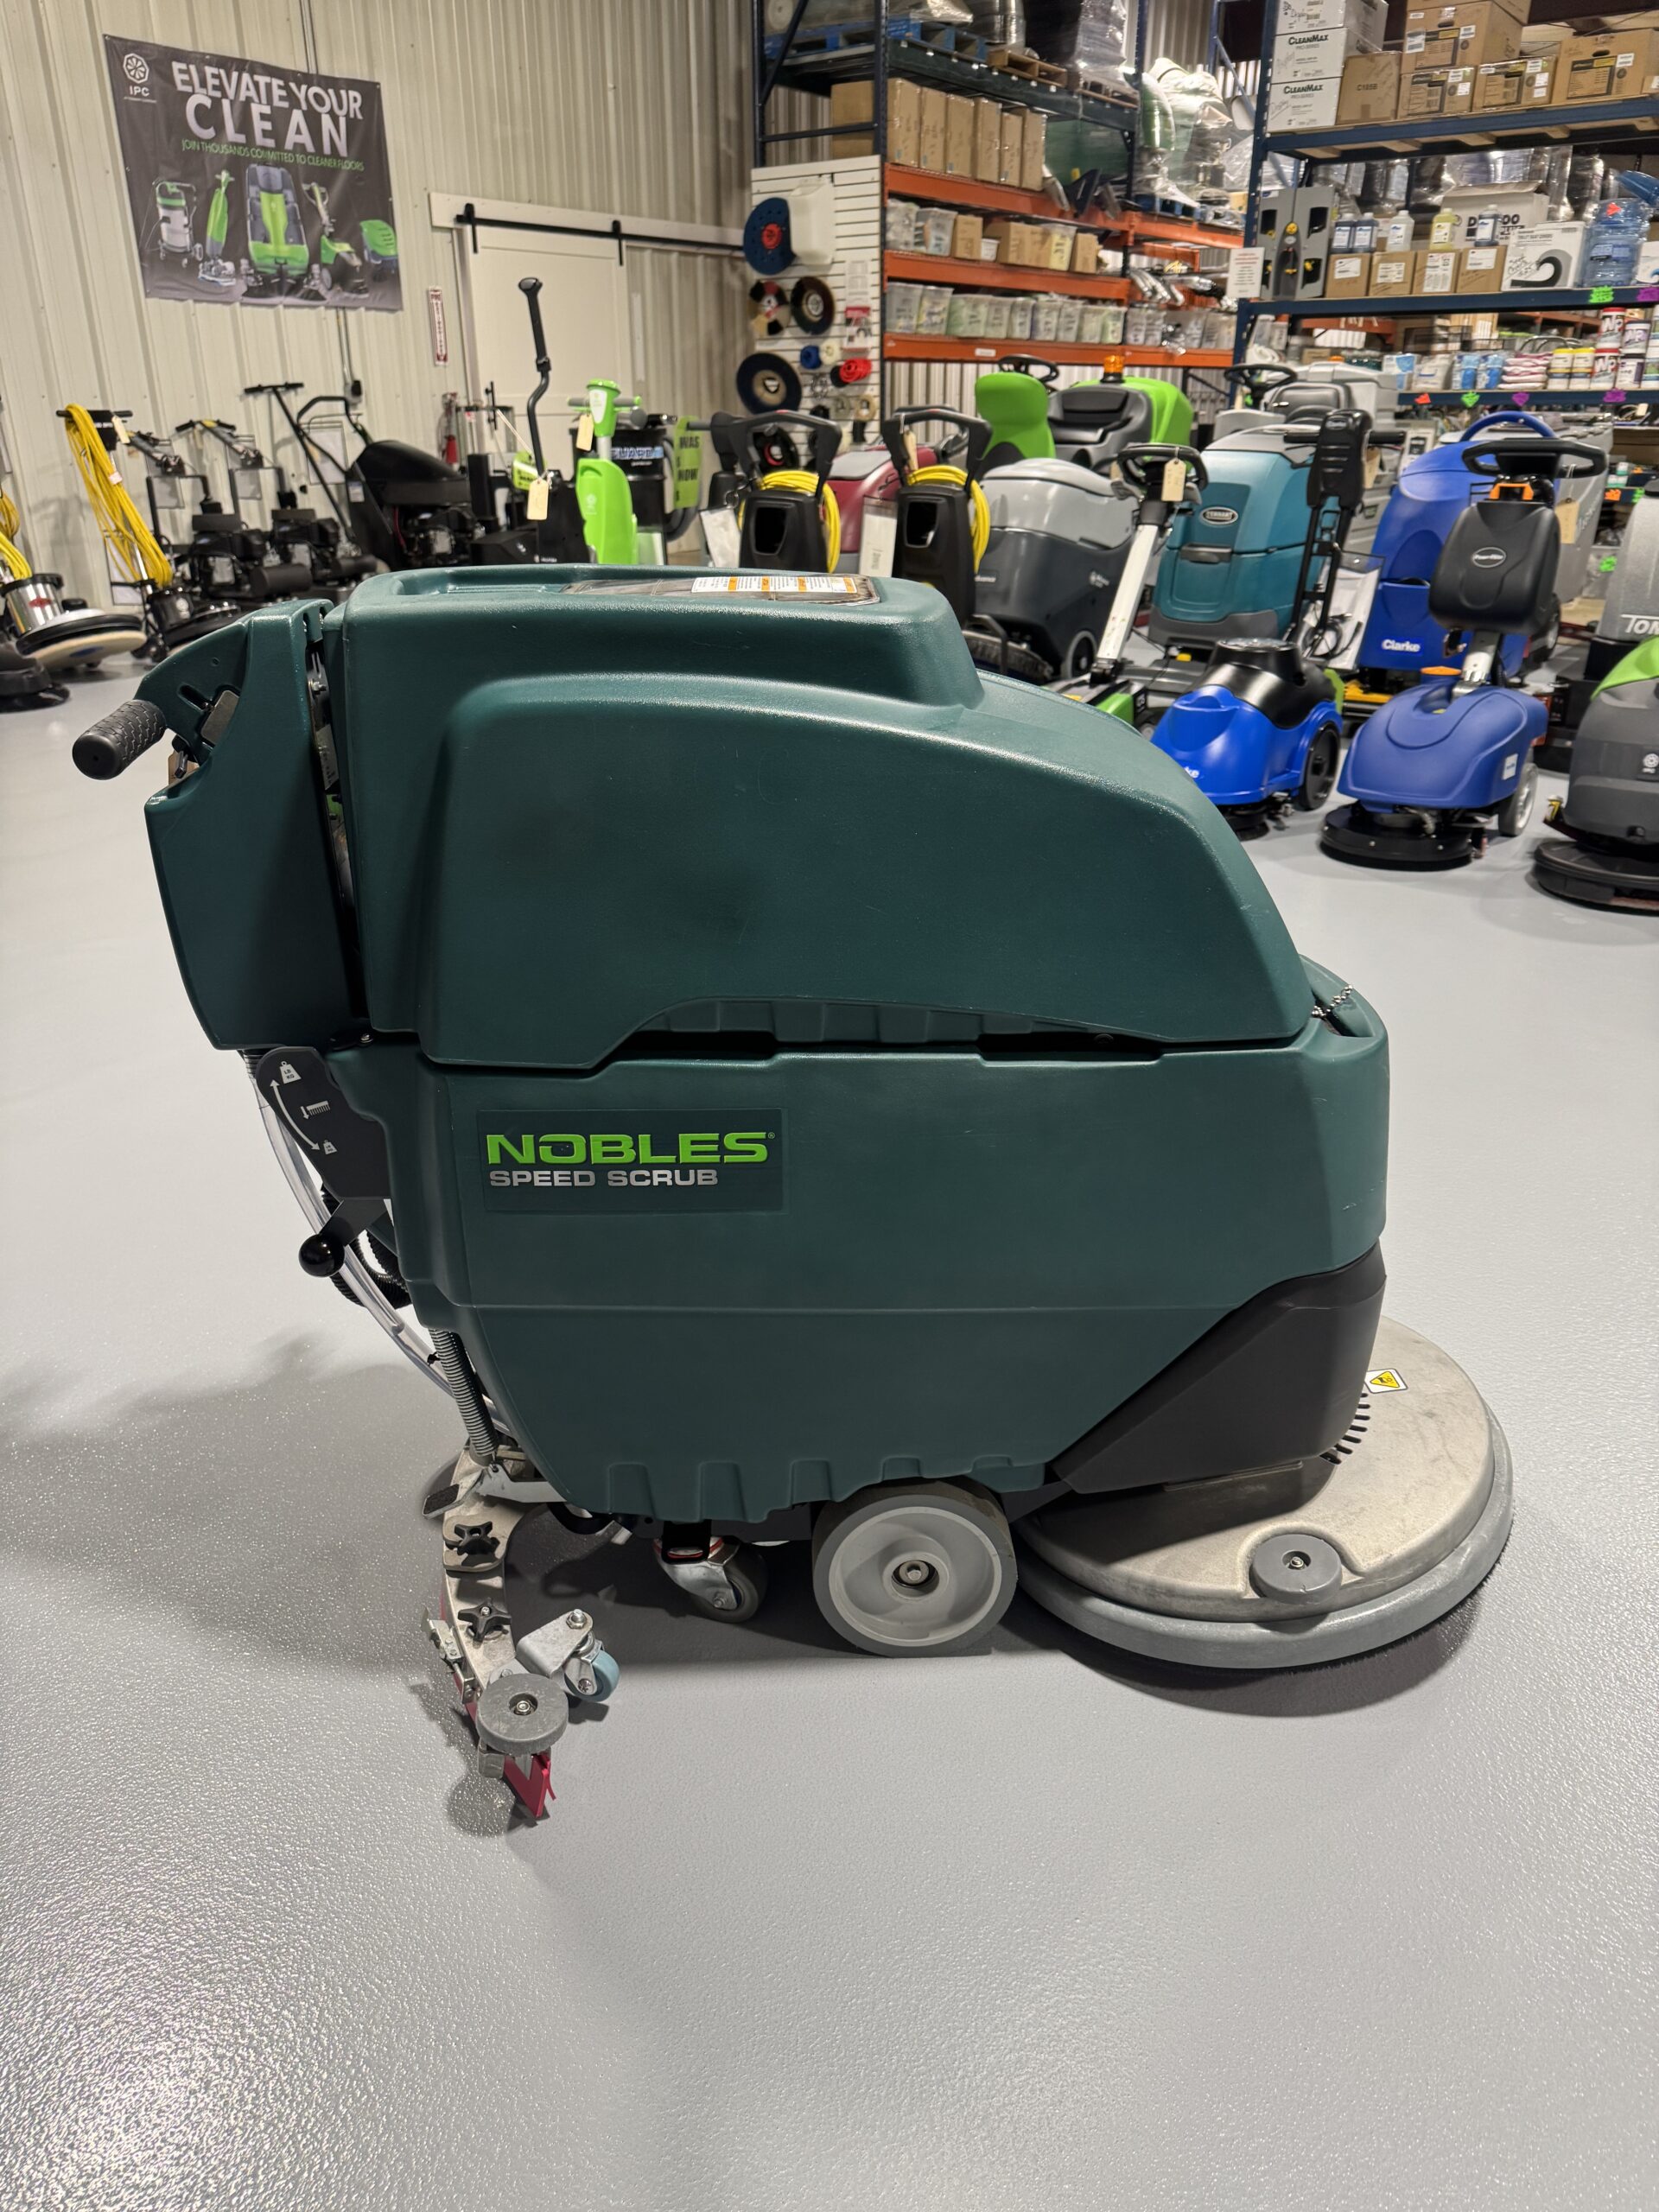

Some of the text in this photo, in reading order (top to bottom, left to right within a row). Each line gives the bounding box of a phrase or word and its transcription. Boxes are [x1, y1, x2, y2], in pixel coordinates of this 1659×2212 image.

[129, 85, 150, 97] IPC
[171, 61, 363, 119] ELEVATE YOUR
[185, 93, 348, 157] CLEAN
[181, 139, 365, 171] JOIN THOUSANDS COMMITTED TO CLEANER FLOORS
[1382, 639, 1421, 652] Clarke
[486, 1132, 768, 1165] NOBLES
[489, 1169, 719, 1187] SPEED SCRUB
